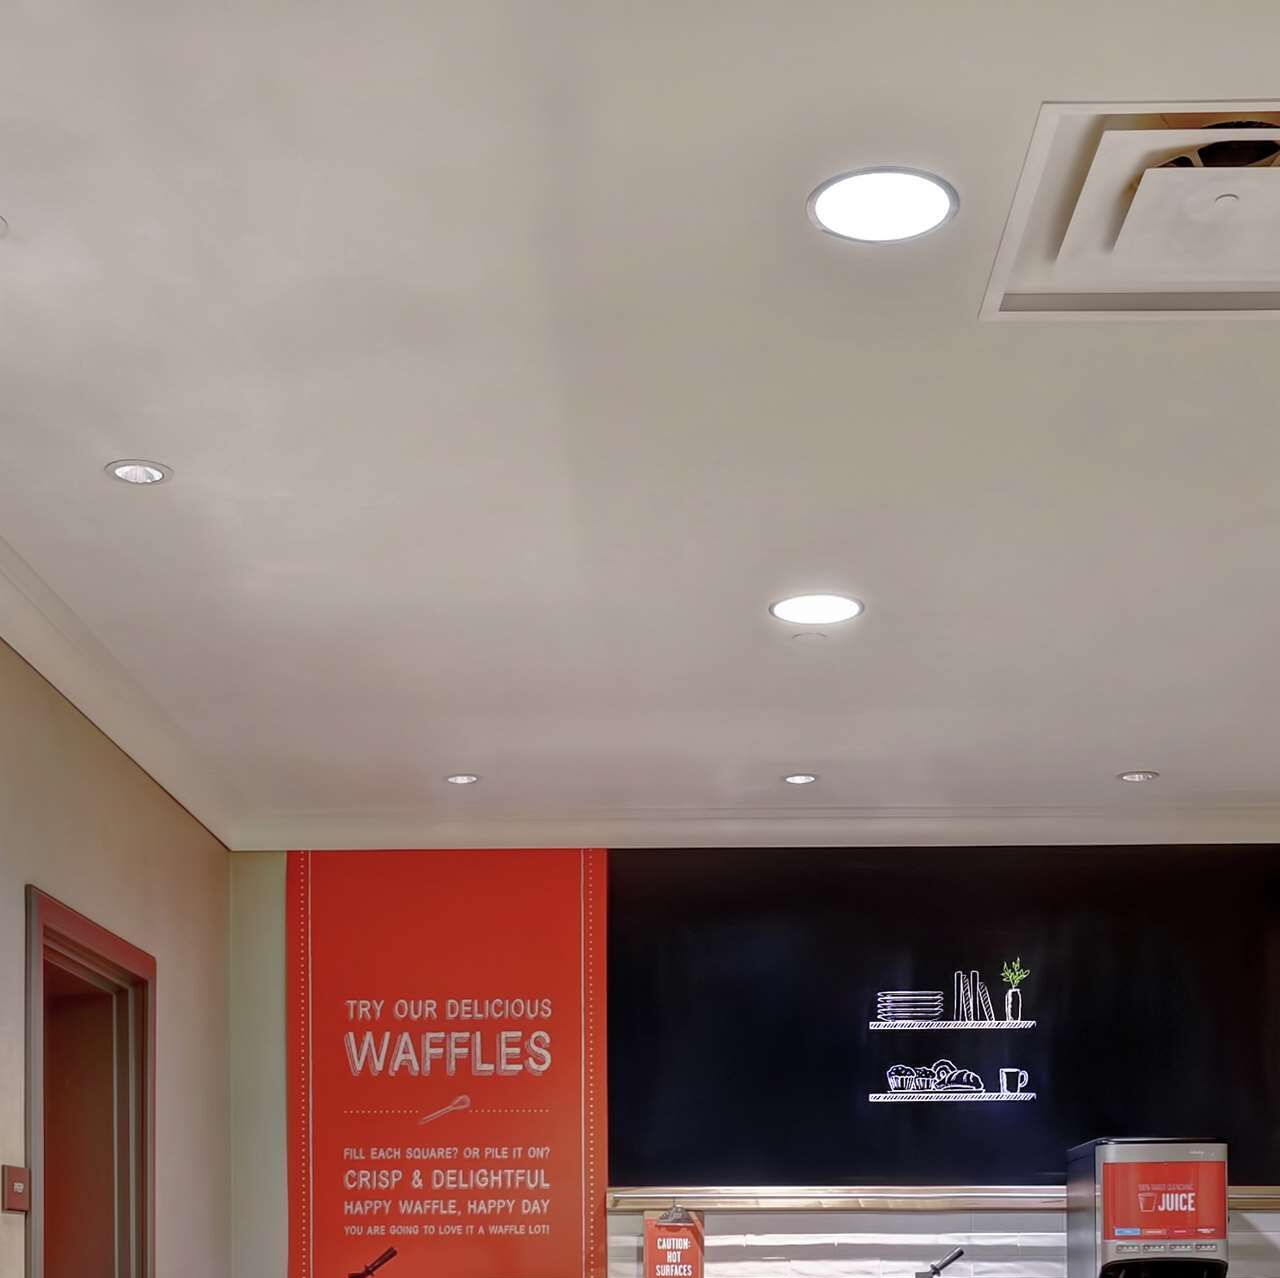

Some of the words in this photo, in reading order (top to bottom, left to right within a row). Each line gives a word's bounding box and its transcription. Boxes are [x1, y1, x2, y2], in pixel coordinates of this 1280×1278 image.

[345, 999, 385, 1020] TRY
[394, 999, 437, 1020] OUR
[445, 998, 552, 1020] DELICIOUS
[344, 1030, 552, 1077] WAFFLES
[343, 1148, 365, 1160] FILL
[370, 1148, 400, 1160] EACH
[405, 1148, 458, 1160] SQUARE?
[463, 1148, 480, 1159] OR
[484, 1148, 508, 1159] PILE
[512, 1148, 523, 1159] IT
[527, 1147, 550, 1159] ON?
[344, 1169, 403, 1189] CRISP
[411, 1169, 423, 1189] &
[431, 1168, 550, 1189] DELIGHTFUL
[344, 1200, 392, 1215] HAPPY
[399, 1200, 462, 1216] WAFFLE,
[467, 1199, 516, 1215] HAPPY
[521, 1199, 550, 1215] DAY
[1158, 1193, 1196, 1211] JUICE
[344, 1225, 363, 1235] YOU
[367, 1225, 386, 1235] ARE
[389, 1225, 419, 1235] GOING
[423, 1225, 435, 1235] TO
[439, 1225, 463, 1235] LOVE
[466, 1225, 474, 1235] IT
[478, 1225, 485, 1235] A
[489, 1225, 525, 1235] WAFFLE
[528, 1224, 550, 1235] LOT!
[656, 1237, 692, 1250] CAUTION:
[666, 1251, 682, 1263] HOT
[655, 1264, 693, 1277] SURFACES
